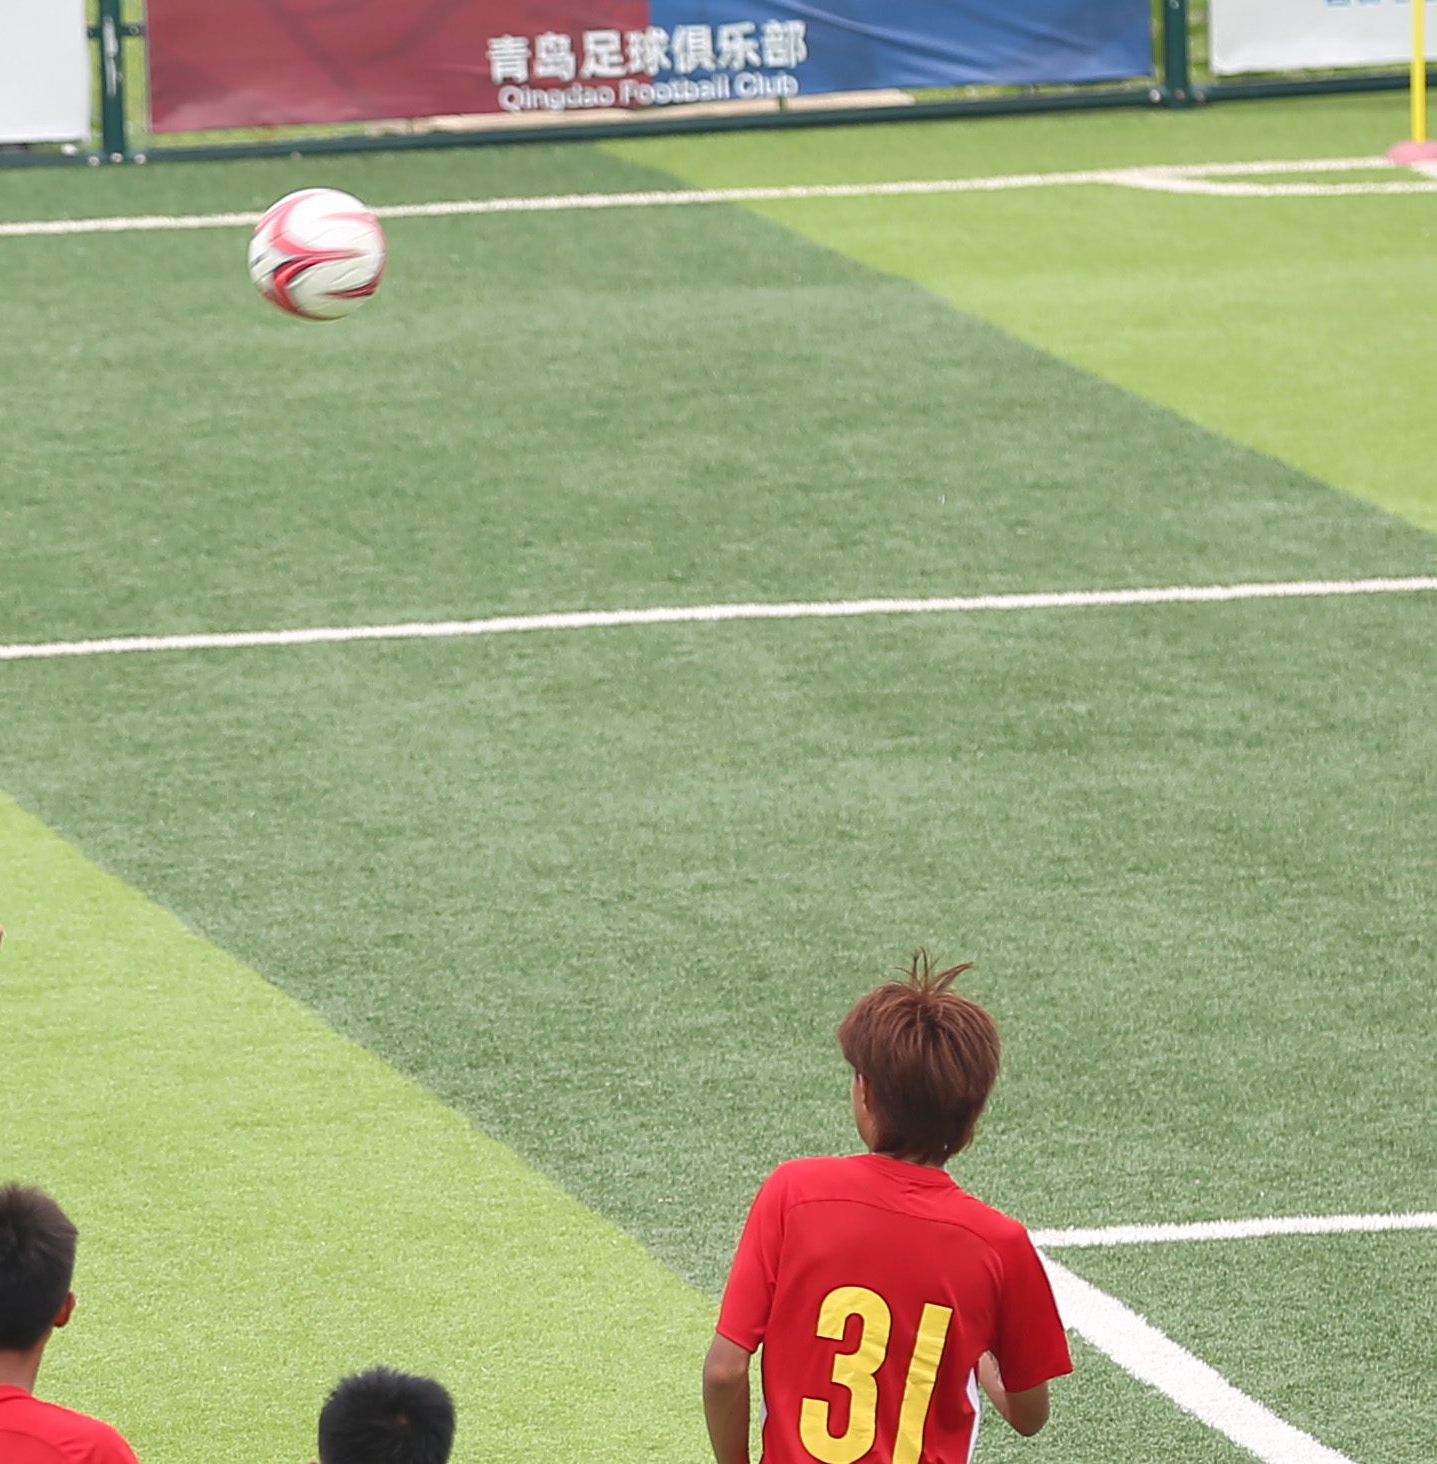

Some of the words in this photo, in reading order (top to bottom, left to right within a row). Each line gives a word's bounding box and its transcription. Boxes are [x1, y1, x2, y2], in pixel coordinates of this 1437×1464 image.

[486, 19, 807, 84] 青岛足球俱乐部
[499, 83, 615, 112] Qingdao
[619, 74, 730, 105] Football
[734, 71, 799, 97] Club
